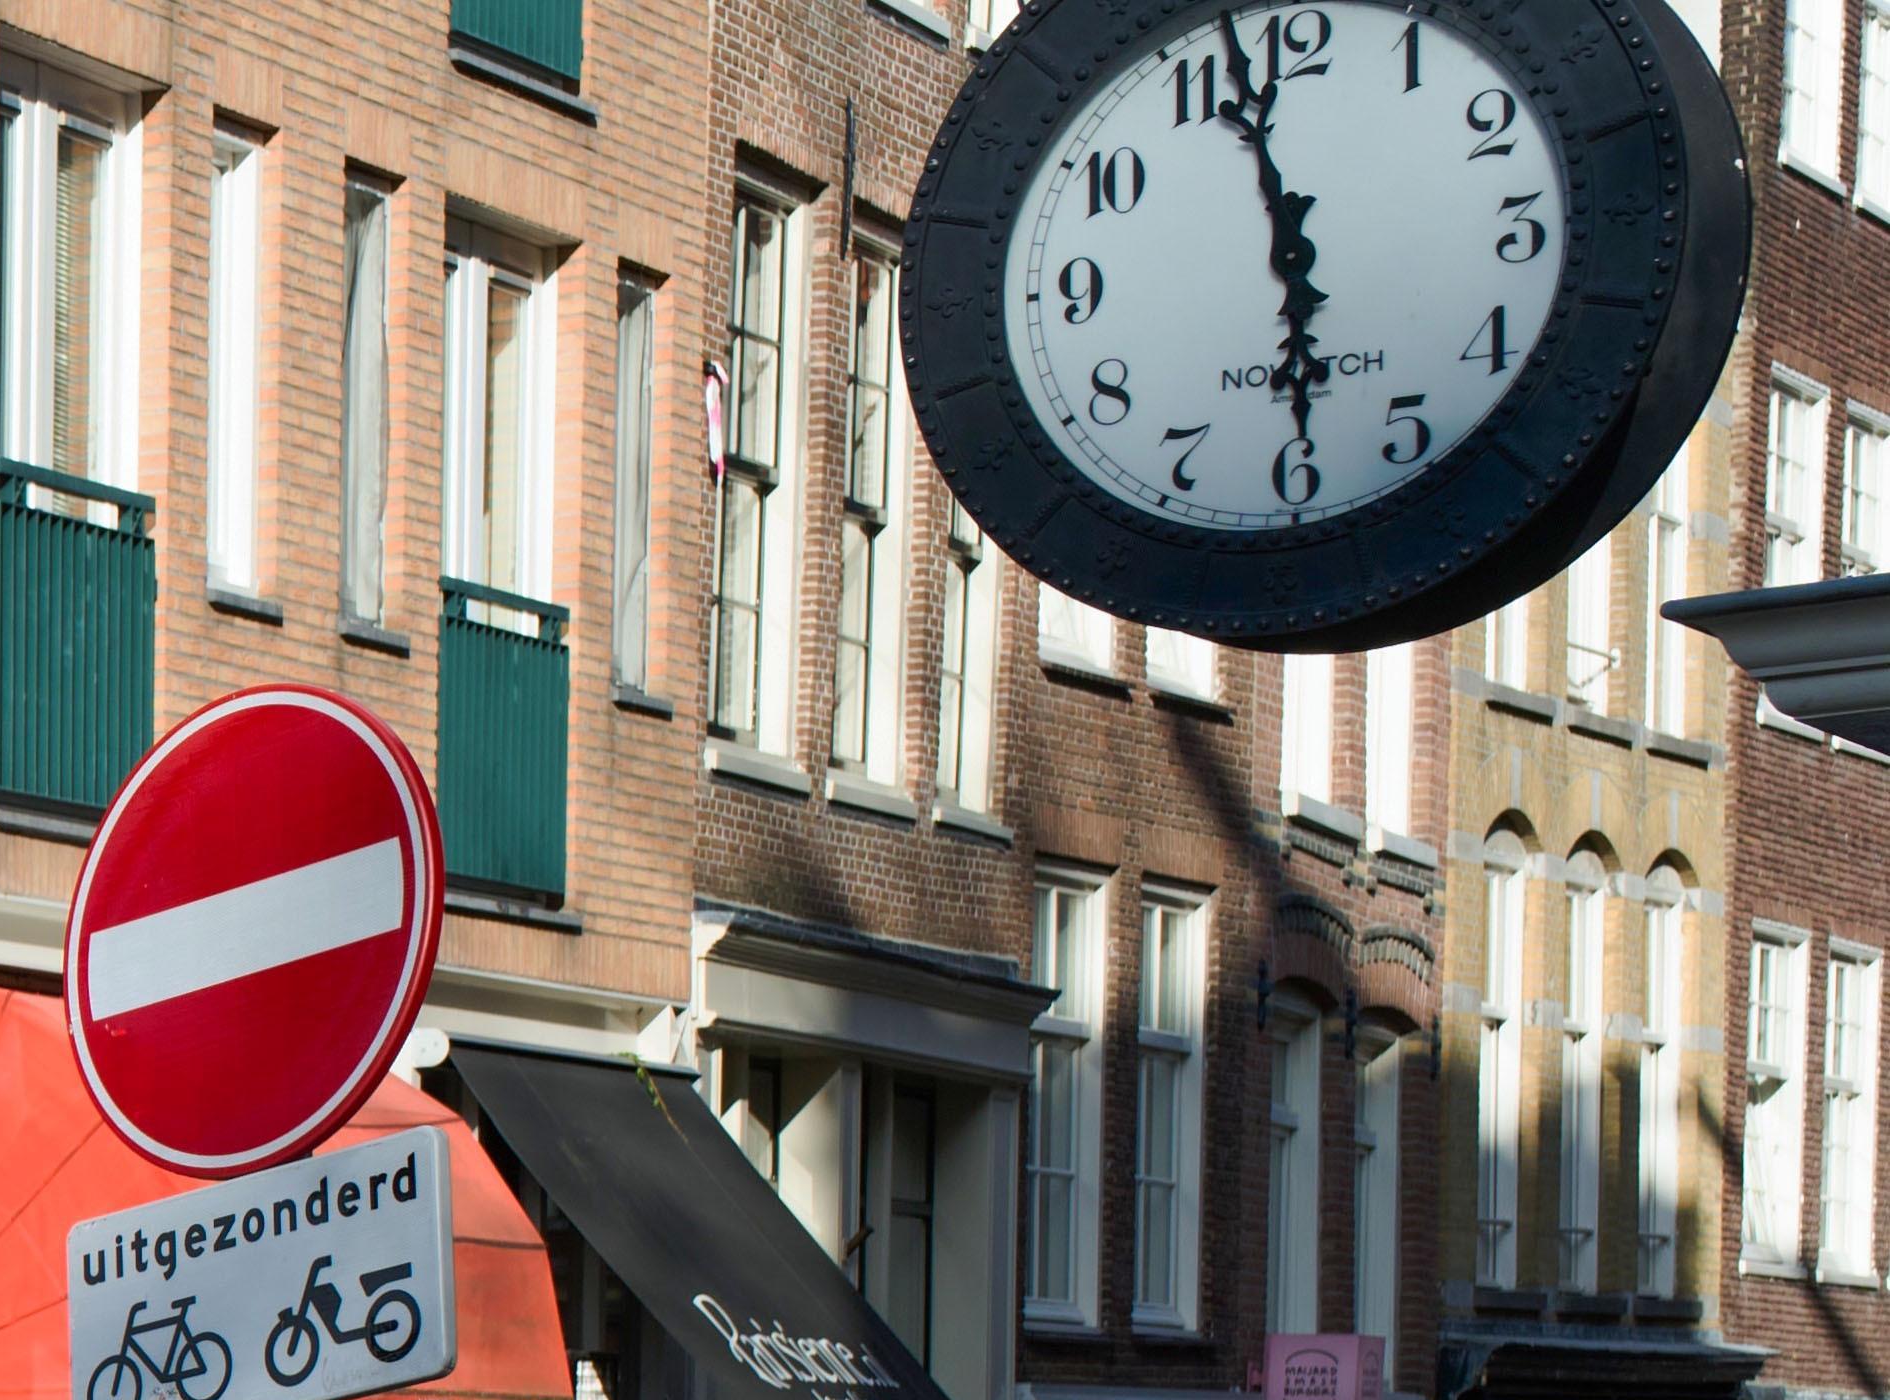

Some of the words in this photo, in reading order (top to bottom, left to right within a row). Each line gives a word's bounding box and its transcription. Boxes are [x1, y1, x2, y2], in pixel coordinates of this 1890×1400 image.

[1255, 10, 1332, 82] 12
[1391, 21, 1422, 93] 1
[1161, 55, 1219, 128] 11
[1466, 89, 1518, 160] 2
[1075, 146, 1145, 219] 10
[1496, 191, 1546, 263] 3
[1058, 257, 1104, 324] 9
[1222, 350, 1383, 391] NOTCH
[1459, 305, 1519, 376] 4
[1089, 358, 1131, 426] 8
[1159, 423, 1211, 491] 7
[1382, 394, 1431, 464] 5
[1272, 436, 1320, 505] 6
[83, 1151, 417, 1287] uitgezonderd
